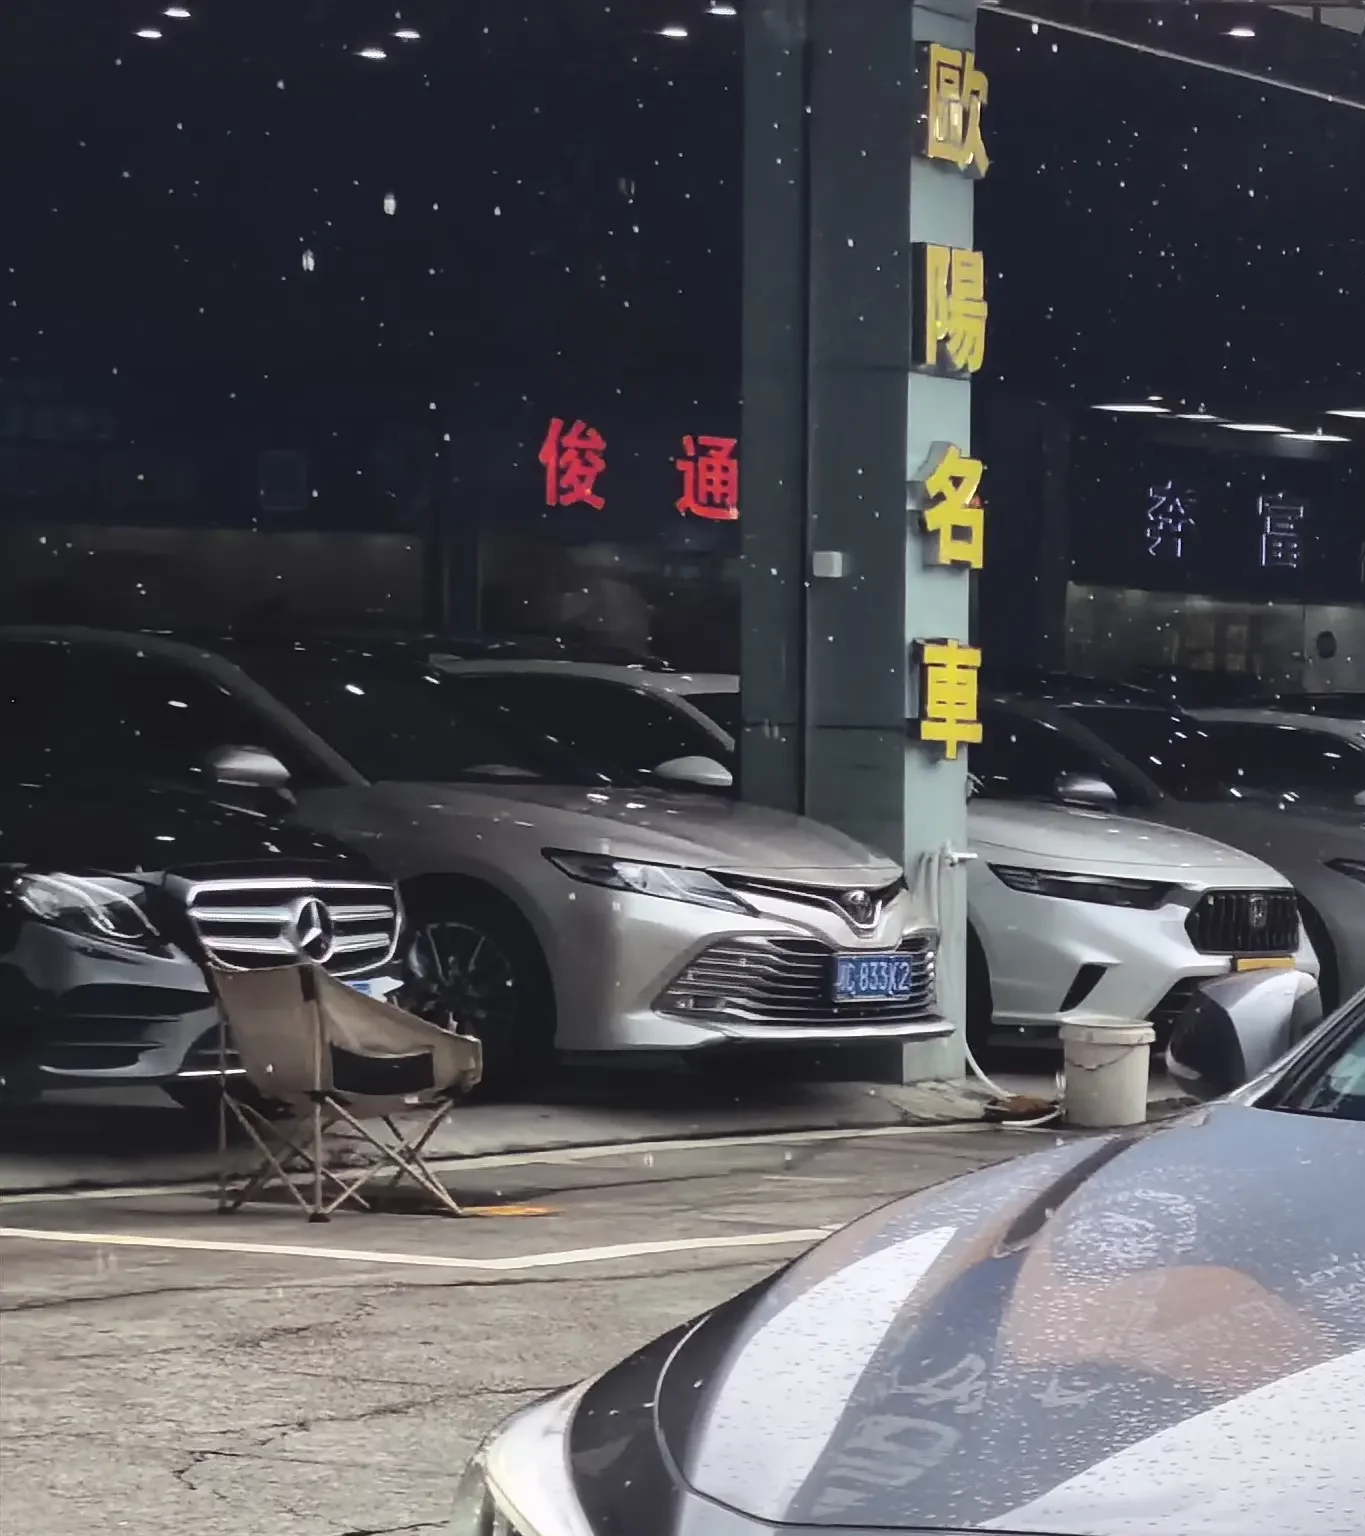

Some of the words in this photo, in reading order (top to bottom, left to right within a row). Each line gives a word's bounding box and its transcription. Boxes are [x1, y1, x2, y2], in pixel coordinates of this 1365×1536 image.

[538, 417, 740, 521] 俊通
[920, 41, 990, 760] 歐陽名車
